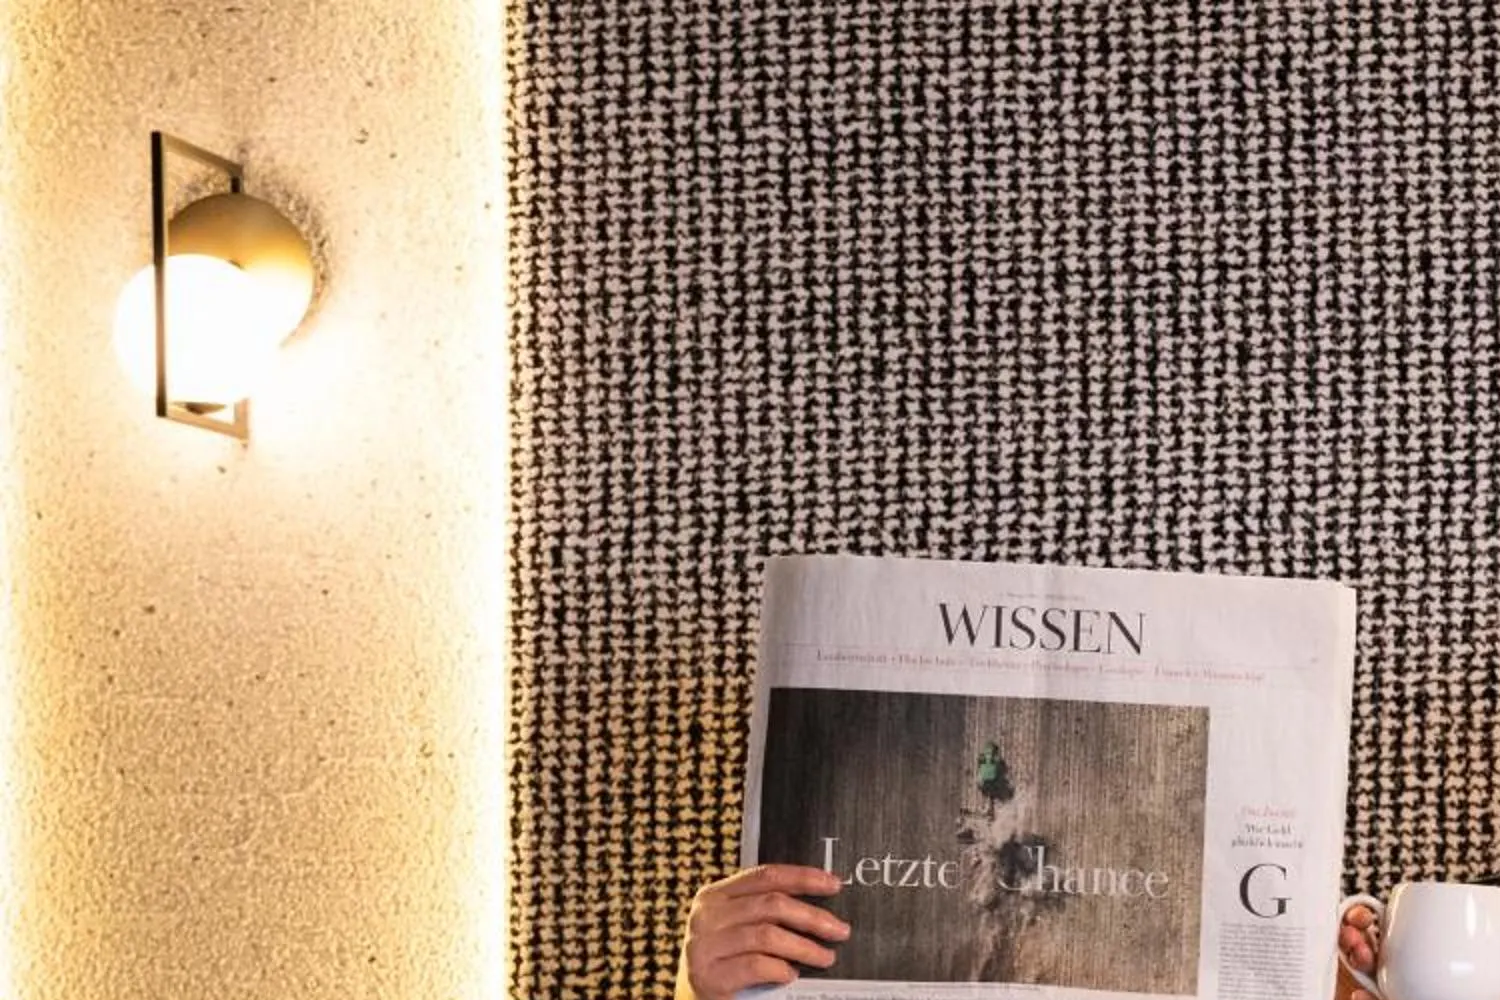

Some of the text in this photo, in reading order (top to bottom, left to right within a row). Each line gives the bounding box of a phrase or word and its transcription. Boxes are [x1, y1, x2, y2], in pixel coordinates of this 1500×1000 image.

[938, 602, 1146, 655] WISSEN
[821, 837, 1169, 897] Letzte Chance
[1239, 863, 1292, 919] G
